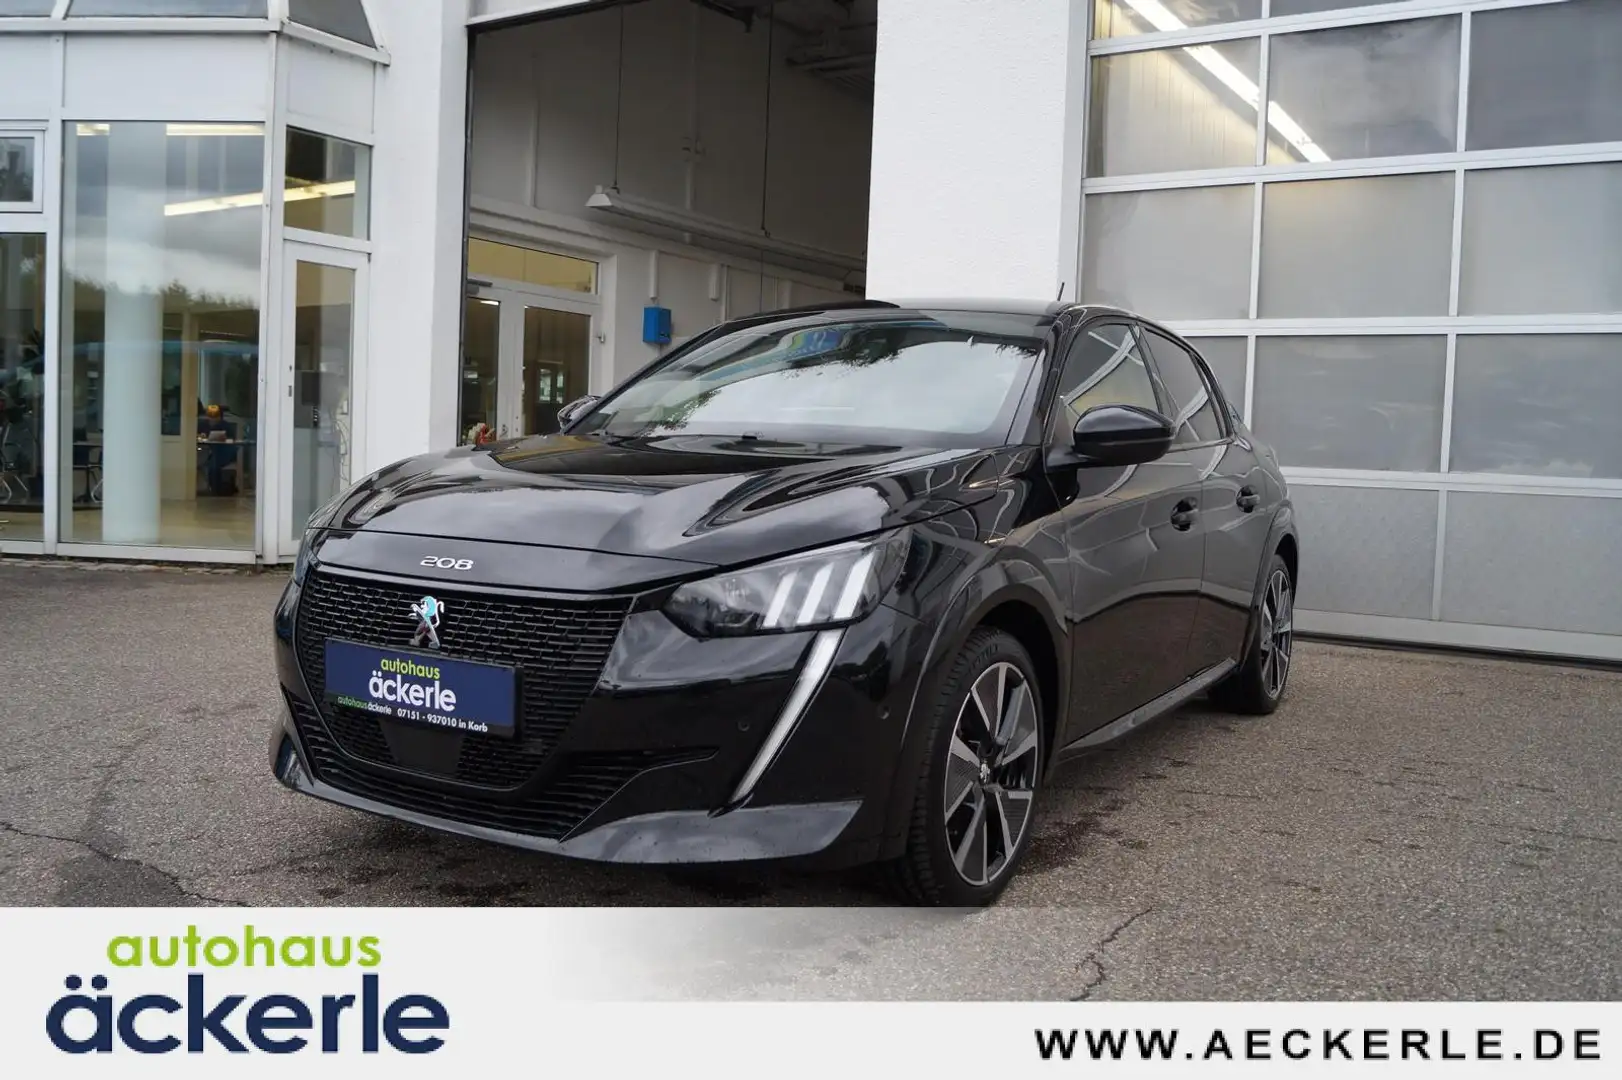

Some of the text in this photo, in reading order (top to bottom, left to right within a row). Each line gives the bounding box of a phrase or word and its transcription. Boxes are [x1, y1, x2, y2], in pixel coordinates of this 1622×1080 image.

[419, 556, 474, 571] 208
[380, 658, 440, 680] autohaus
[368, 670, 456, 711] äckerle
[397, 707, 420, 721] 07151
[427, 714, 457, 728] 937010
[458, 718, 467, 729] in
[468, 721, 488, 733] Korb
